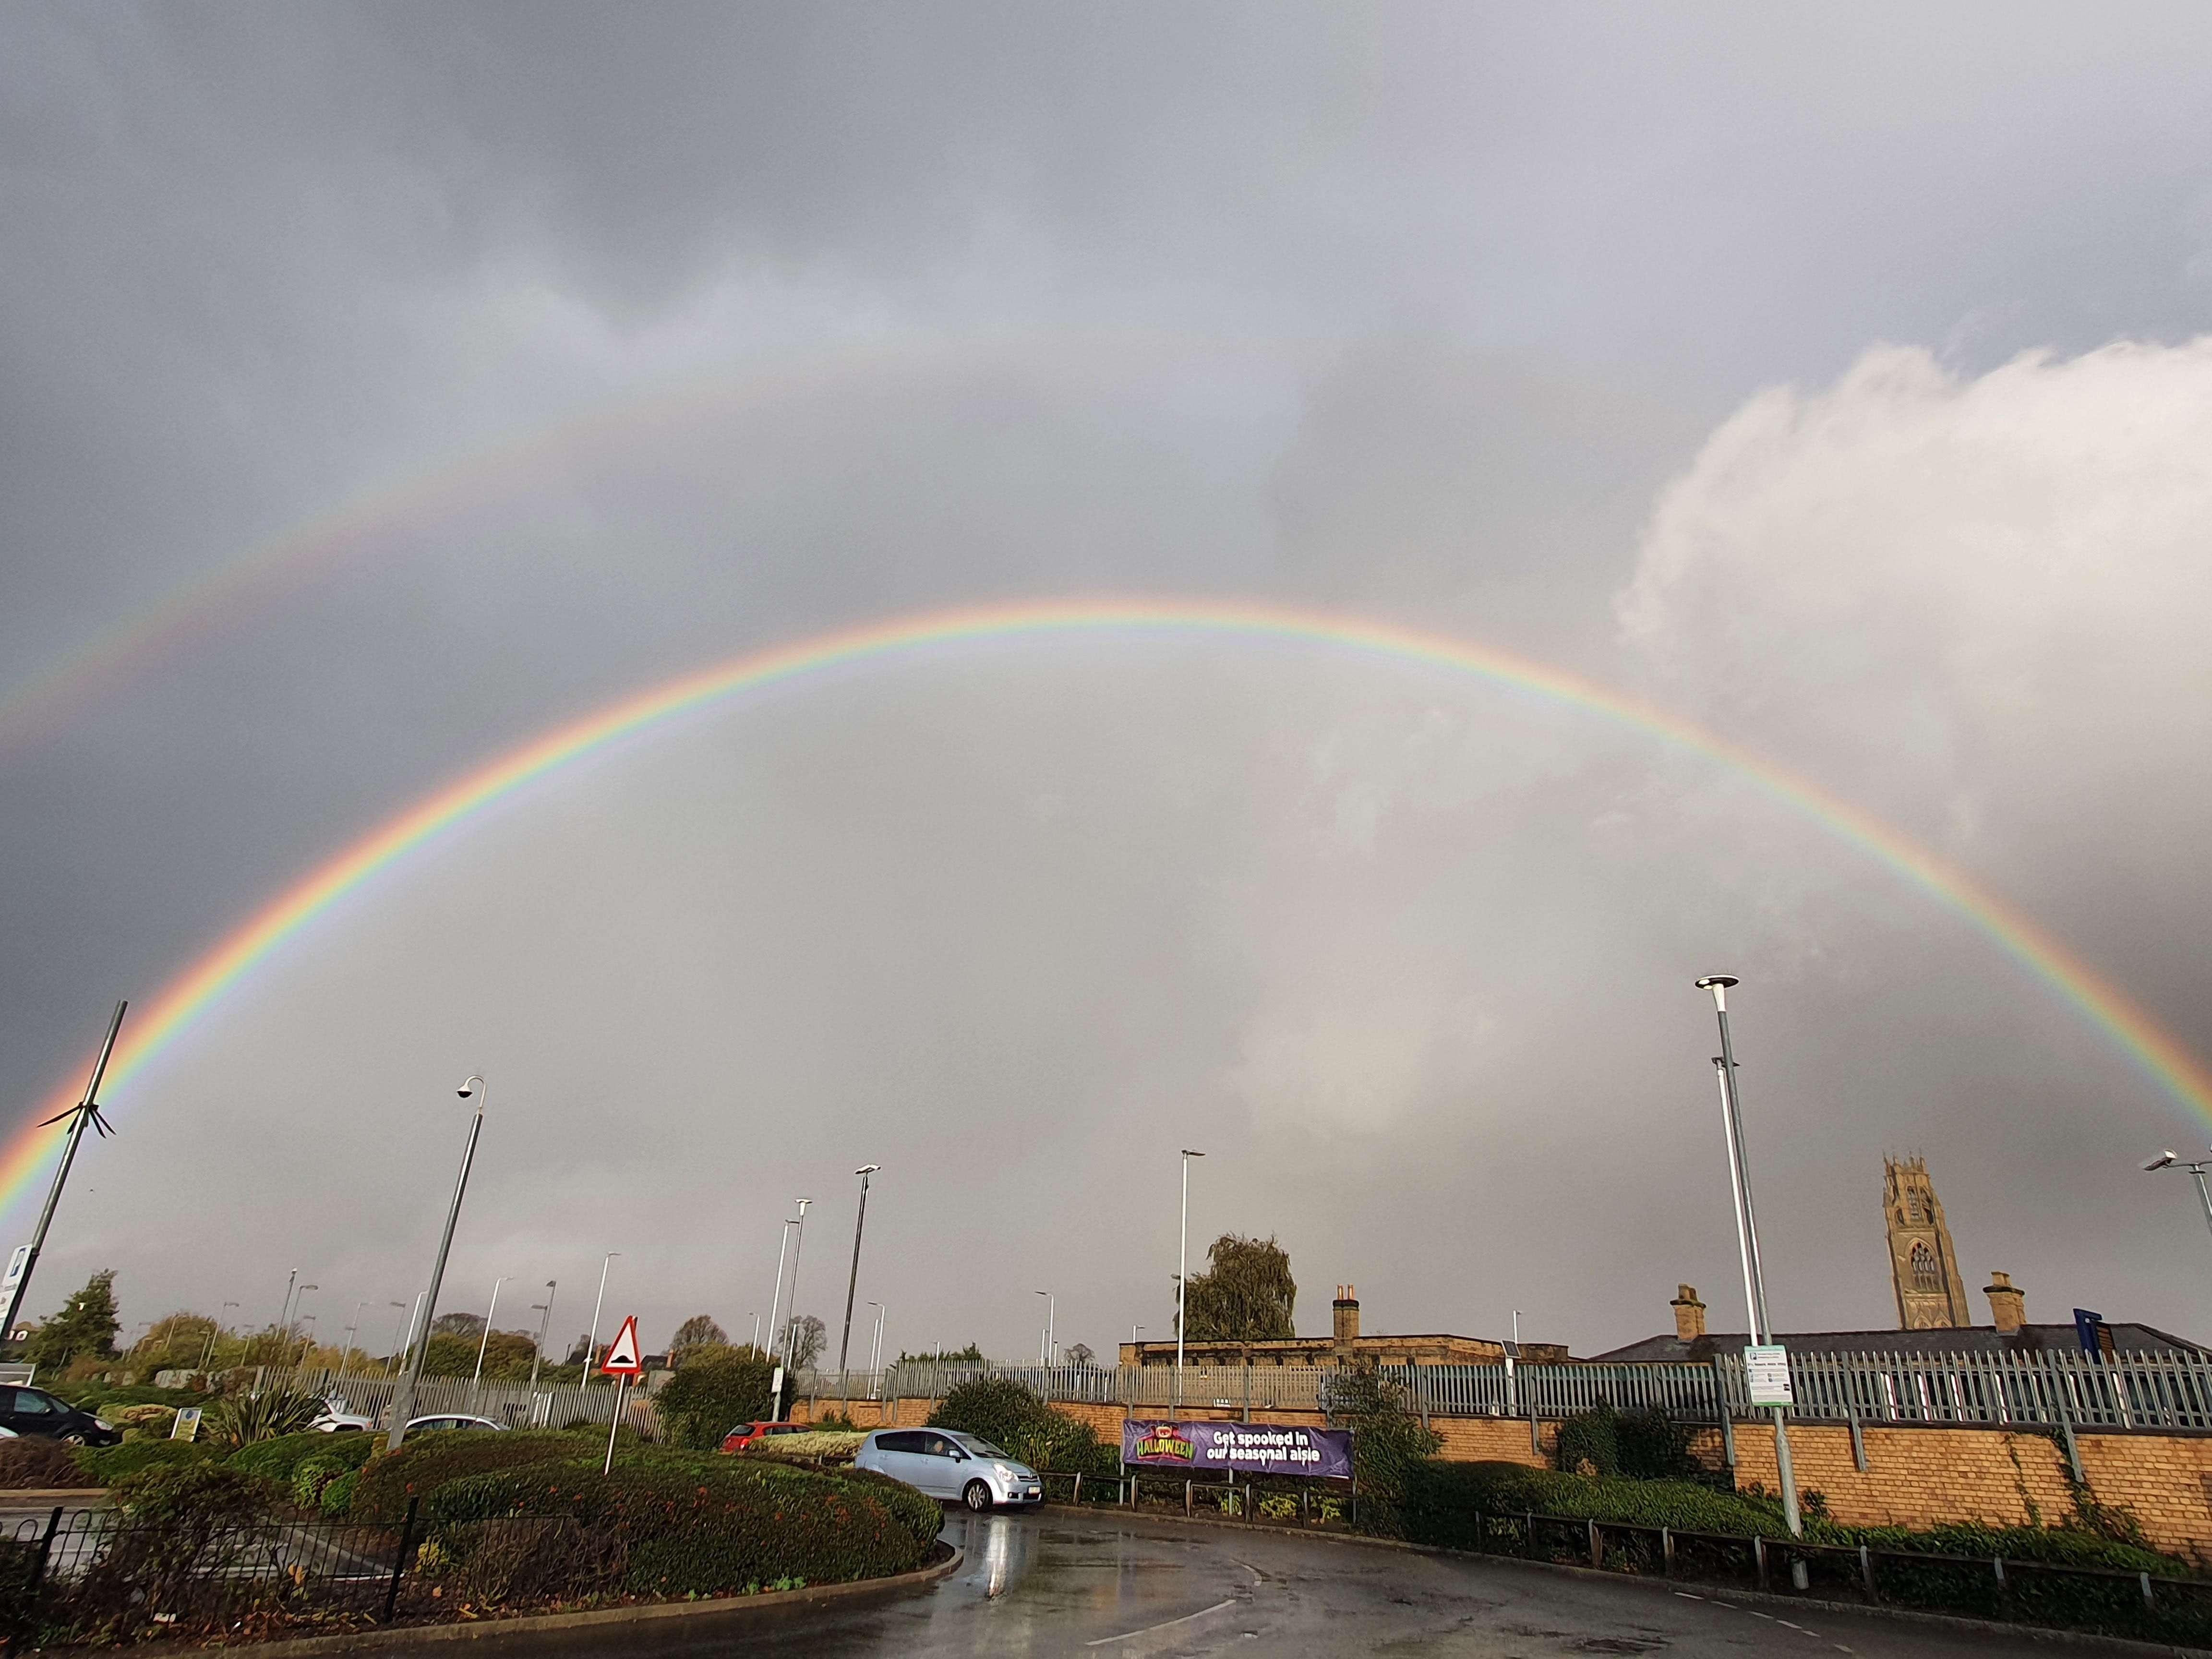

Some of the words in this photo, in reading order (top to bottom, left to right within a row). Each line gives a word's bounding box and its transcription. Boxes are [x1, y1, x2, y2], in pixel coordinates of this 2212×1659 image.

[1214, 1431, 1235, 1445] Get
[1237, 1431, 1293, 1447] spooked
[1296, 1431, 1308, 1445] in
[1137, 1439, 1193, 1459] HALLOWEEN
[1207, 1448, 1227, 1459] our
[1229, 1446, 1287, 1463] seasonal
[1290, 1447, 1320, 1464] aisle
